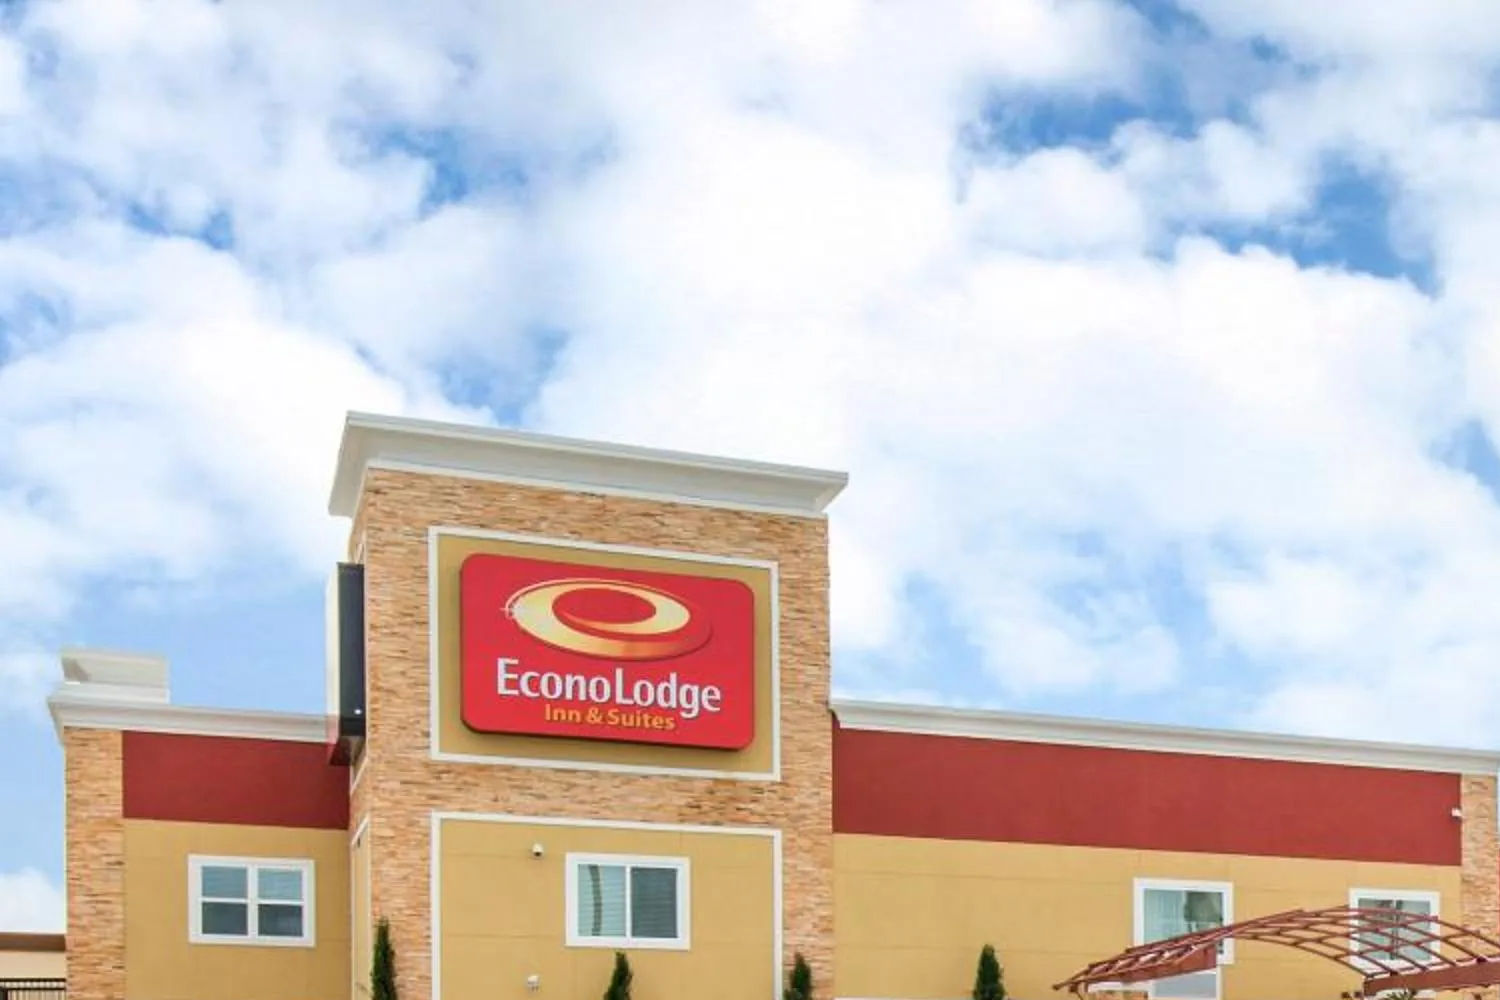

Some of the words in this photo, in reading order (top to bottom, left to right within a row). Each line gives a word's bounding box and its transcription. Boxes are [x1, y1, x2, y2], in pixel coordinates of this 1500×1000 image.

[497, 657, 721, 718] EconoLodge
[544, 703, 581, 723] Inn
[586, 706, 602, 725] &
[607, 707, 676, 731] Suites
